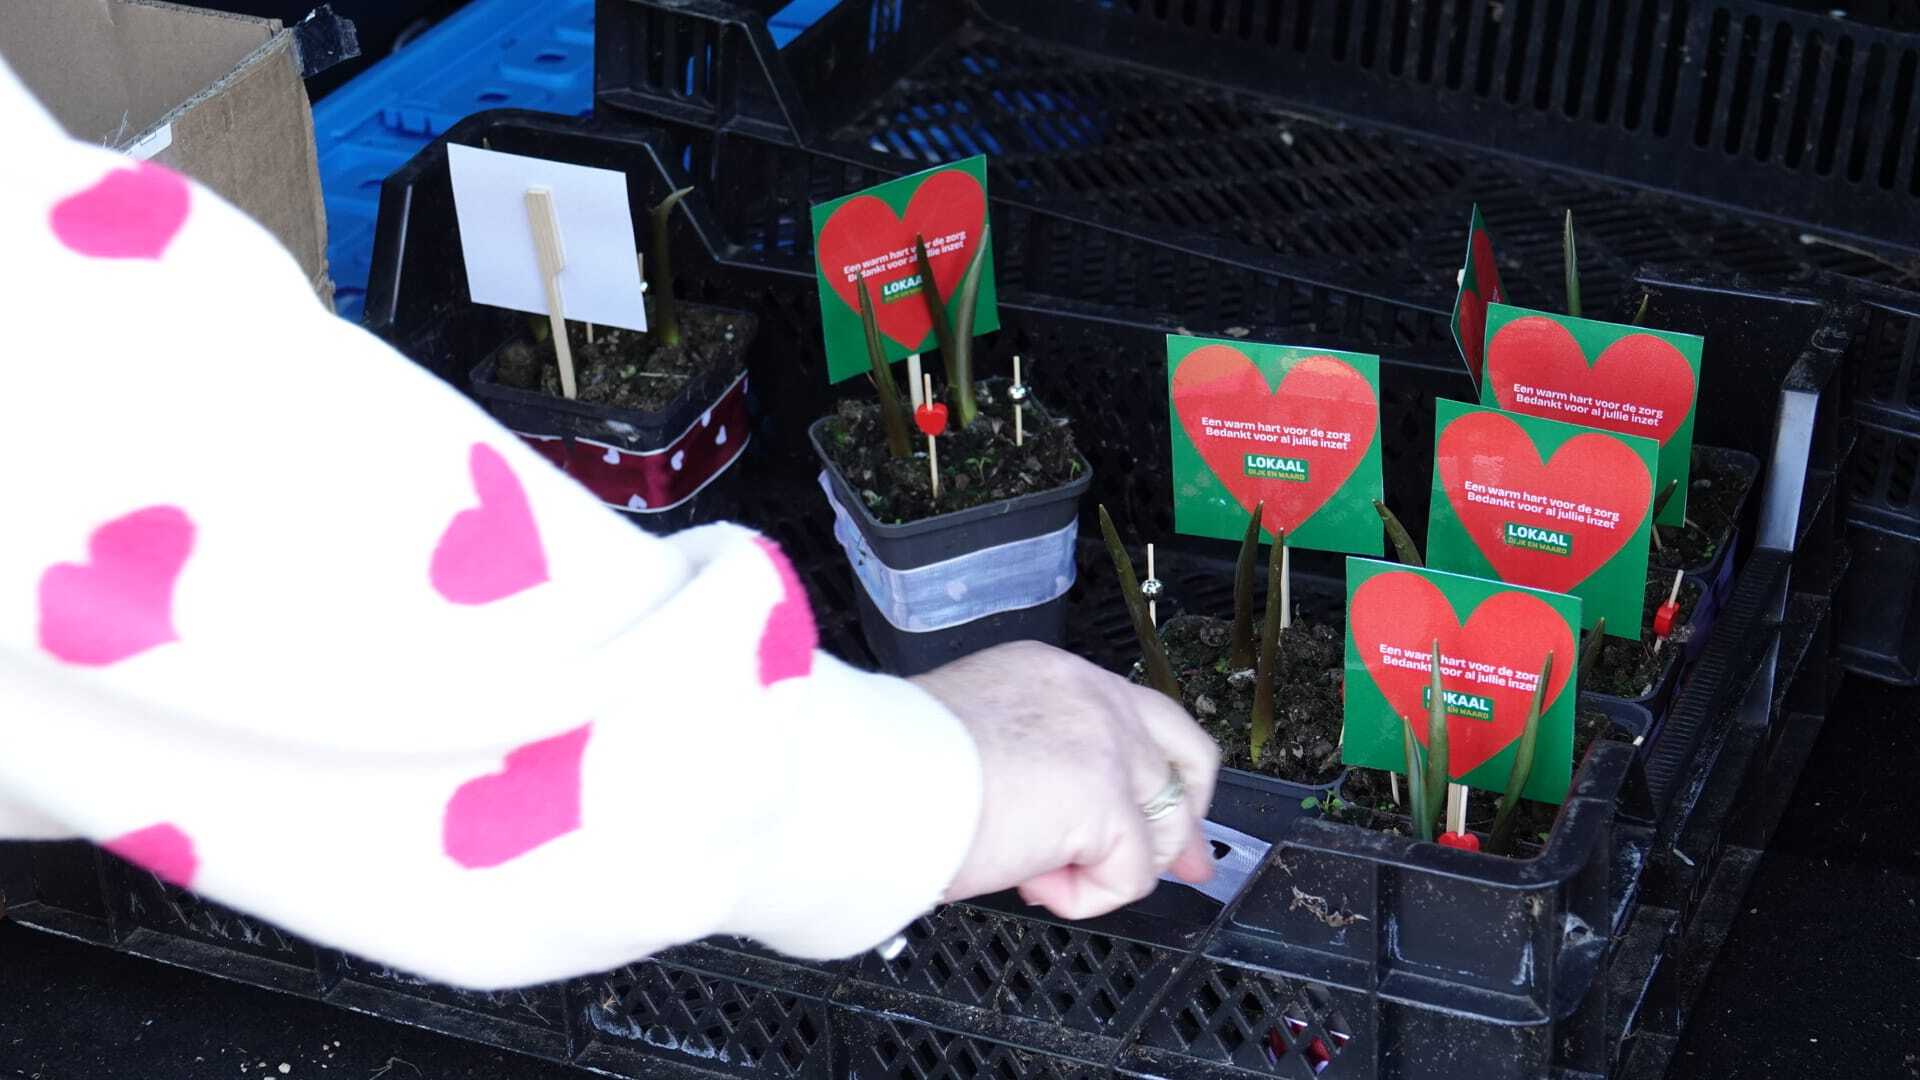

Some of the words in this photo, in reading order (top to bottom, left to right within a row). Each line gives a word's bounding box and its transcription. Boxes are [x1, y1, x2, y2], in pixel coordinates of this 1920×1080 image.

[863, 255, 888, 269] warm
[890, 248, 909, 259] hart
[933, 237, 944, 247] de
[946, 231, 966, 242] zorg
[887, 258, 907, 270] voor
[942, 241, 964, 254] inzet
[884, 275, 923, 295] LOKAA
[1513, 384, 1534, 394] Een
[1536, 388, 1568, 401] warm
[1570, 392, 1592, 405] hart
[1595, 400, 1621, 409] voor
[1623, 403, 1637, 412] de
[1639, 407, 1664, 419] zorg
[1516, 394, 1562, 409] Bedankt
[1564, 403, 1589, 413] voor
[1591, 408, 1600, 416] al
[1603, 409, 1629, 421] jullie
[1632, 414, 1659, 426] inzet
[1201, 417, 1222, 426] Een
[1224, 420, 1255, 430] warm
[1258, 423, 1280, 433] hart
[1283, 426, 1308, 435] voor
[1310, 427, 1324, 437] de
[1326, 431, 1351, 441] zorg
[1206, 427, 1252, 439] Bedankt
[1254, 432, 1279, 442] voor
[1280, 434, 1290, 443] al
[1292, 435, 1318, 446] jullie
[1321, 439, 1348, 450] inzet
[1247, 456, 1304, 472] LOKAAL
[1465, 481, 1486, 493] Een
[1487, 486, 1521, 499] warm
[1523, 492, 1547, 504] hart
[1549, 499, 1576, 509] voor
[1578, 503, 1592, 513] de
[1594, 508, 1619, 521] zorg
[1467, 493, 1515, 509] Bedankt
[1517, 502, 1543, 513] voor
[1546, 507, 1556, 516] al
[1557, 509, 1584, 522] jullie
[1587, 516, 1615, 529] inzet
[1509, 525, 1568, 546] LOKAAL
[1380, 644, 1402, 655] Een
[1441, 654, 1467, 667] hart
[1468, 661, 1496, 672] voor
[1498, 666, 1513, 676] de
[1464, 670, 1476, 680] al
[1477, 671, 1505, 686] jullie
